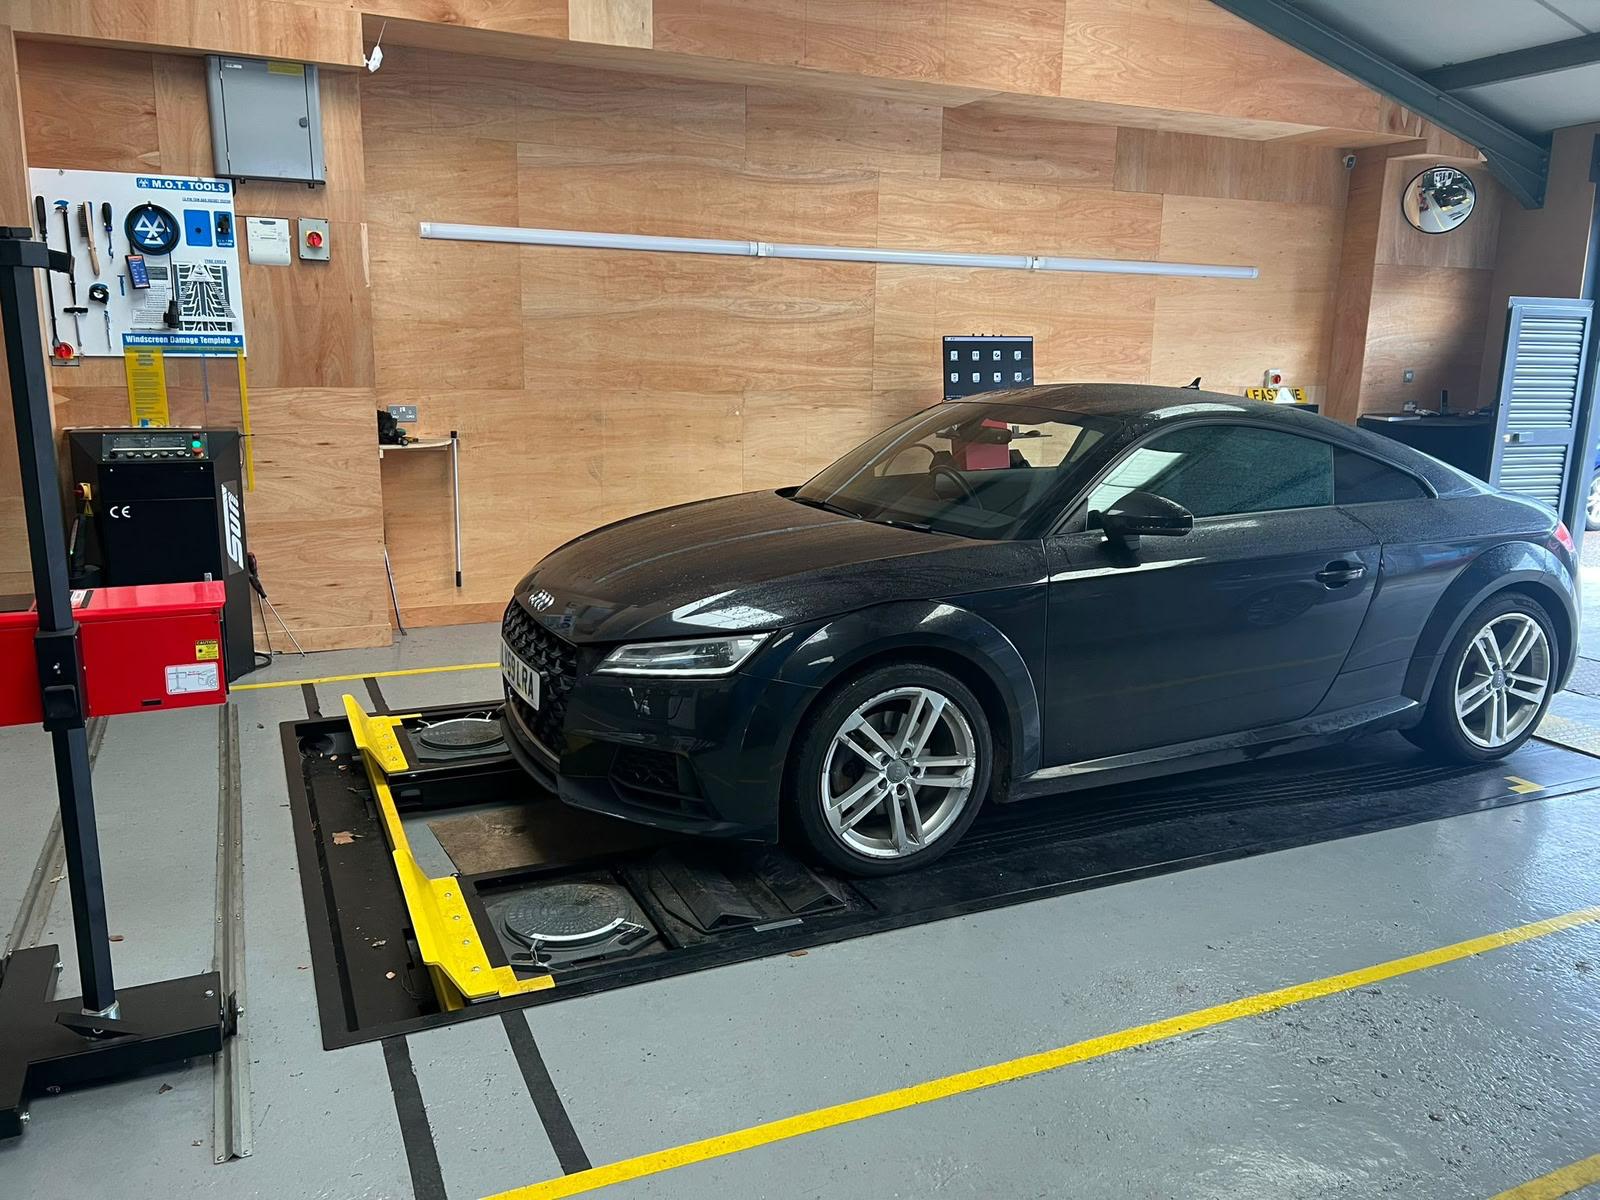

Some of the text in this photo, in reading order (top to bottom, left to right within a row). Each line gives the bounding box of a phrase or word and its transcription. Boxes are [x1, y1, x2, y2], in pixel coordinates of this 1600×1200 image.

[152, 180, 225, 191] M.O.T. TOOLS
[125, 335, 231, 345] Windscreen Damage Template
